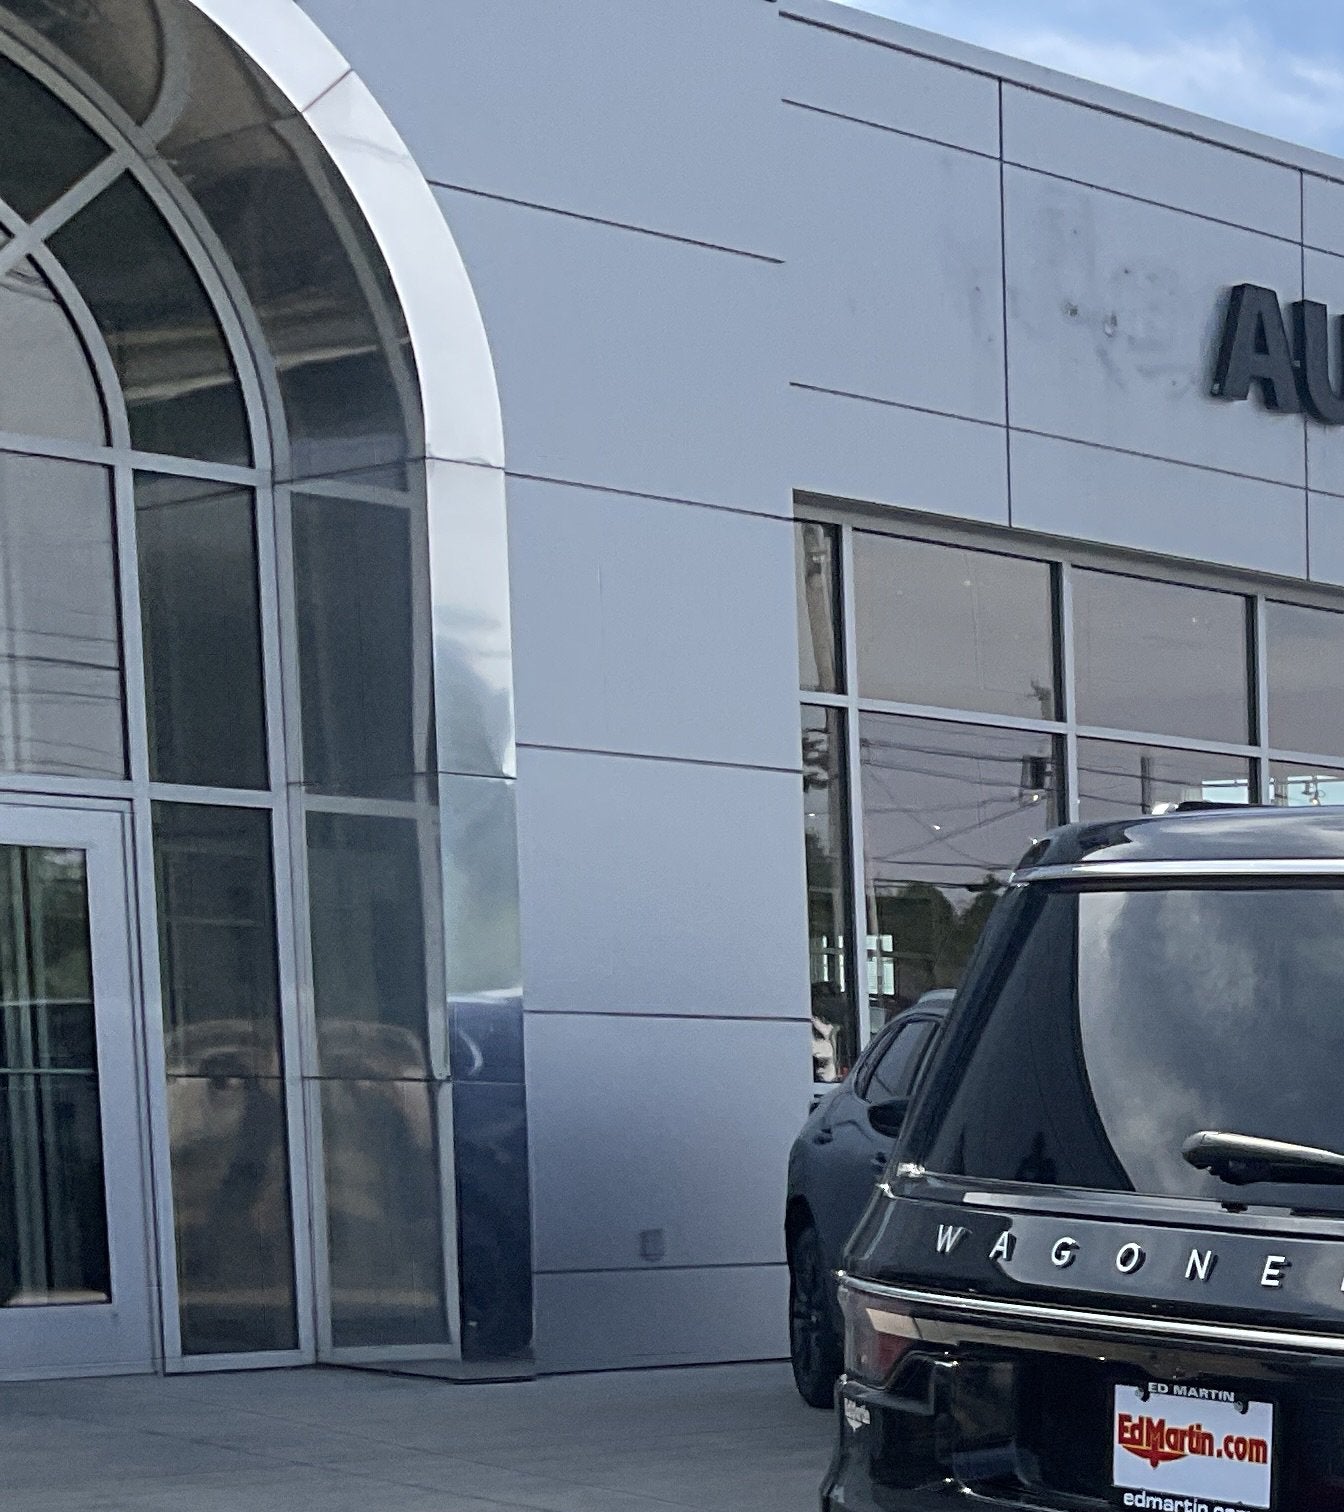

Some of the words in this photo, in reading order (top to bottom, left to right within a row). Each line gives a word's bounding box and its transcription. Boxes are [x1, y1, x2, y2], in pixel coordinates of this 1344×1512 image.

[1148, 1382, 1169, 1394] ED
[1173, 1384, 1235, 1402] MARTIN
[1118, 1413, 1268, 1465] EdMartin.com
